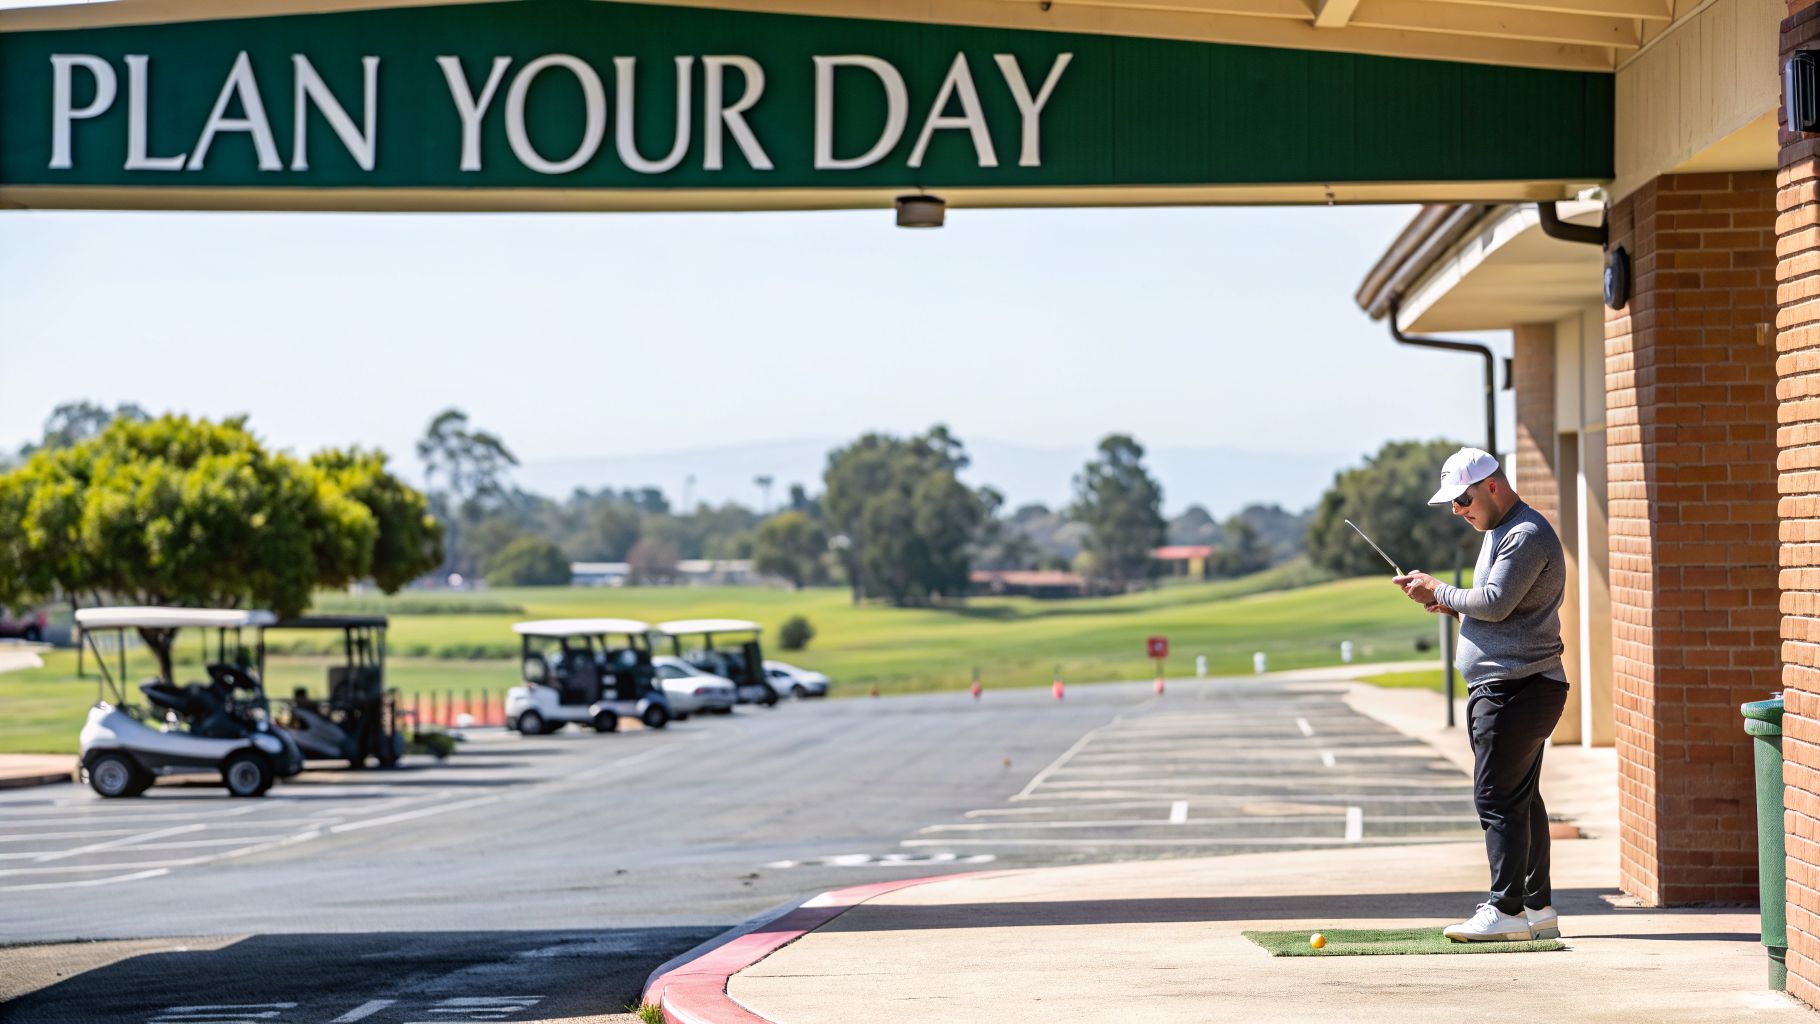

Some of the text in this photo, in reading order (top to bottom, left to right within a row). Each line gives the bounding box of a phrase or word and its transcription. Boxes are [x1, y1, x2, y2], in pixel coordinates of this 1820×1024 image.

[50, 52, 1073, 173] PLAN YOUR DAY
